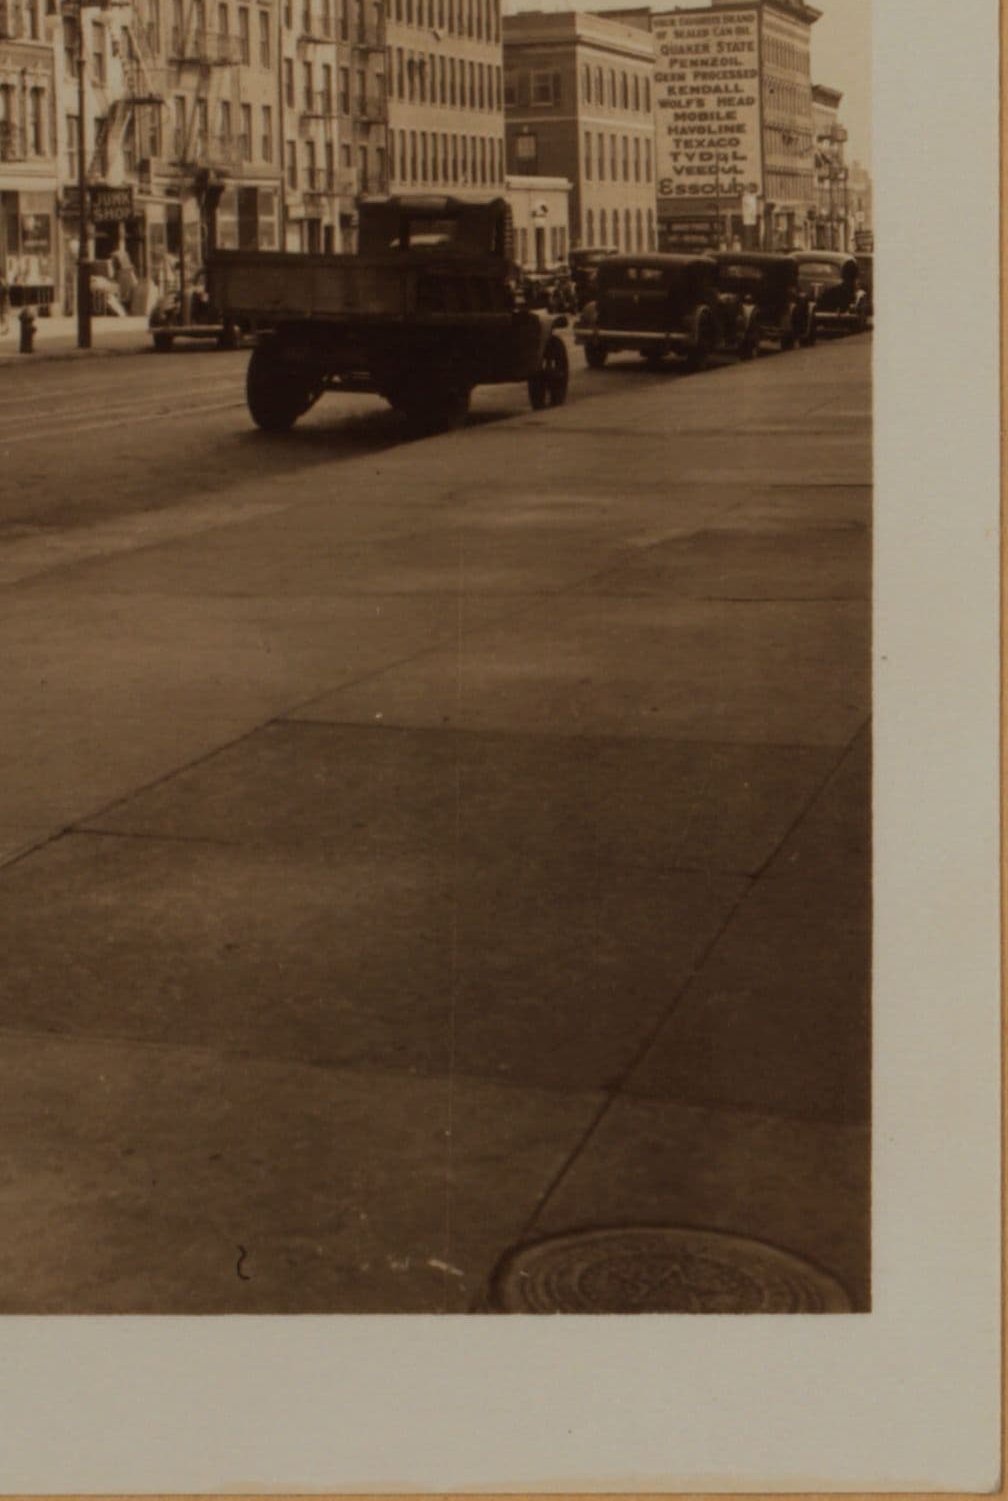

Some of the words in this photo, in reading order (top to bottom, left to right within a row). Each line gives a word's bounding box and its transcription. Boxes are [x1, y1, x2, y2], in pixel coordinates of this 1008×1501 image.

[723, 14, 755, 24] BRAND
[674, 28, 709, 40] SEALED
[713, 27, 733, 37] CAN
[660, 43, 710, 56] QUAKER
[717, 41, 754, 53] STATE
[669, 56, 744, 68] PENNZOIL
[693, 69, 758, 80] PROCESSED
[667, 83, 744, 96] KENDALL
[658, 98, 705, 109] WOLF'S
[717, 96, 755, 107] HEAD
[674, 111, 737, 121] MOBILE
[667, 123, 746, 135] HAVOLINE
[673, 137, 740, 149] TEXACO
[93, 194, 131, 207] JUNK
[93, 207, 133, 220] SHOP
